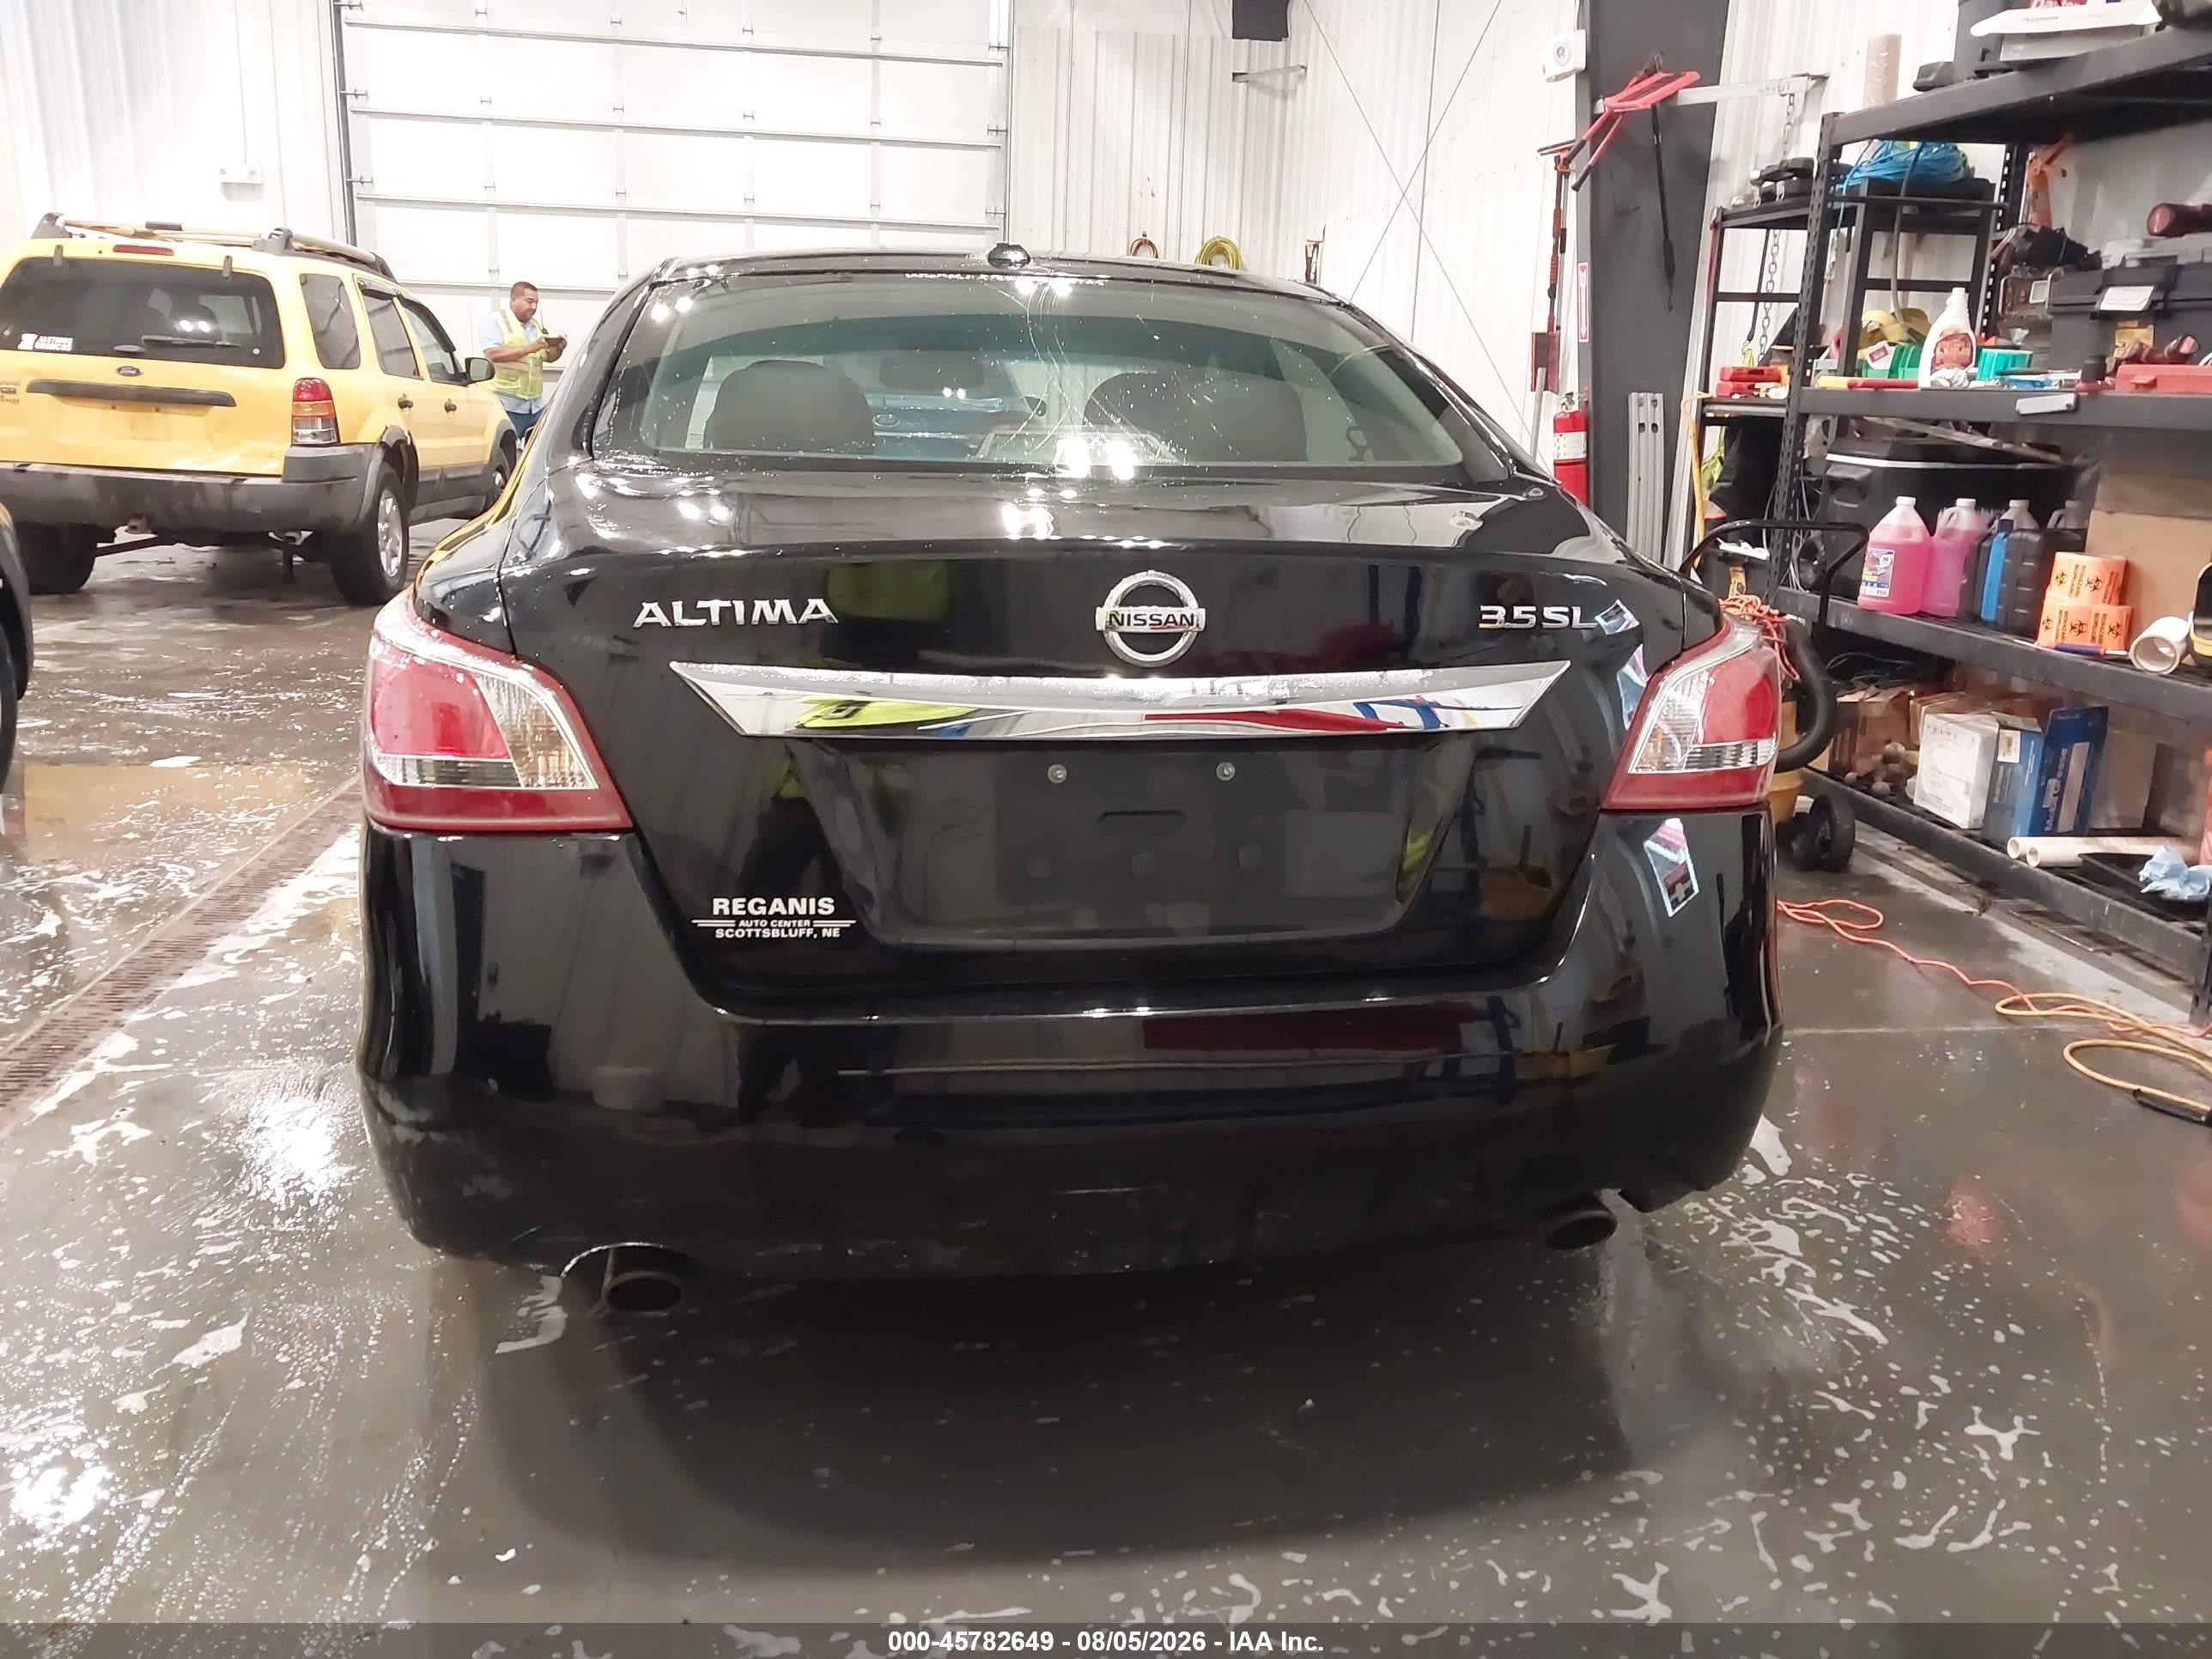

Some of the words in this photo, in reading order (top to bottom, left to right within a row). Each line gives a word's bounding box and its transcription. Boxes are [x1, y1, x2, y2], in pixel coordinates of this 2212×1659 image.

[632, 599, 839, 629] ALTIMA
[1109, 613, 1194, 627] NISSAN
[1479, 605, 1536, 629] 3.5
[1541, 606, 1598, 629] SL
[713, 897, 835, 915] REGANIS
[715, 927, 817, 939] SCOTTSBLUFF,
[822, 927, 841, 938] NE
